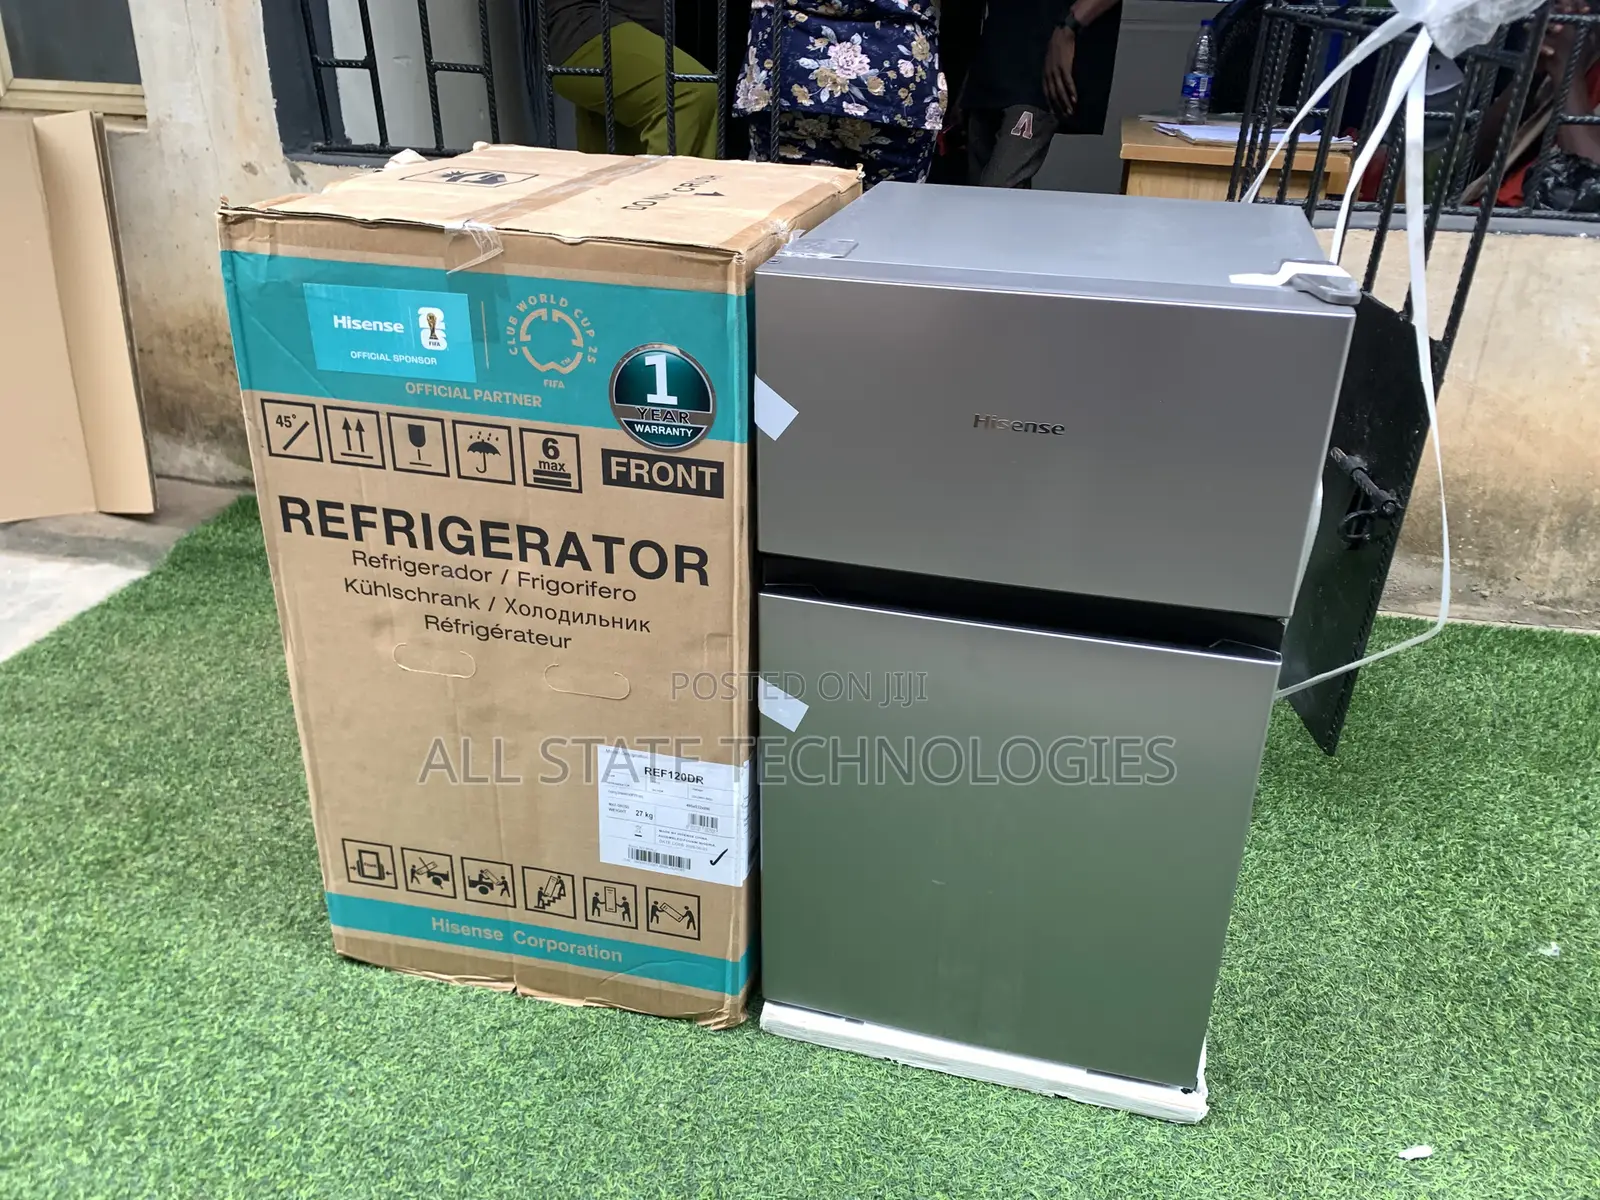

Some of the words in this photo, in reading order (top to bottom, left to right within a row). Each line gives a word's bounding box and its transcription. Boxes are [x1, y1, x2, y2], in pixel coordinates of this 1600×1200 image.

[333, 314, 405, 334] Hisense
[506, 315, 519, 356] CLUB
[516, 293, 569, 313] WORLD
[573, 308, 595, 338] CUP
[587, 346, 598, 364] 25
[350, 350, 391, 362] OFFICIAL
[393, 354, 437, 366] SPONSOR
[543, 379, 565, 389] FIFA
[645, 354, 678, 406] 1
[405, 381, 471, 400] OFFICIAL
[474, 389, 542, 408] PARTNER
[275, 413, 297, 429] 45°
[636, 406, 690, 424] YEAR
[973, 413, 1066, 436] Hisense
[634, 424, 693, 437] WARRANTY
[541, 437, 561, 460] 6
[538, 460, 566, 473] max
[610, 456, 718, 491] FRONT
[278, 495, 710, 587] REFRIGERATOR
[352, 550, 493, 582] Refrigerador
[517, 571, 637, 602] Frigorifero
[344, 577, 481, 610] Kühlschrank
[505, 597, 651, 633] Холодильник
[424, 614, 573, 649] Réfrigérateur
[644, 766, 704, 785] REF120DR
[635, 809, 644, 817] 27
[645, 811, 654, 821] kg
[431, 916, 504, 942] Hisense
[513, 930, 623, 963] Corporation
